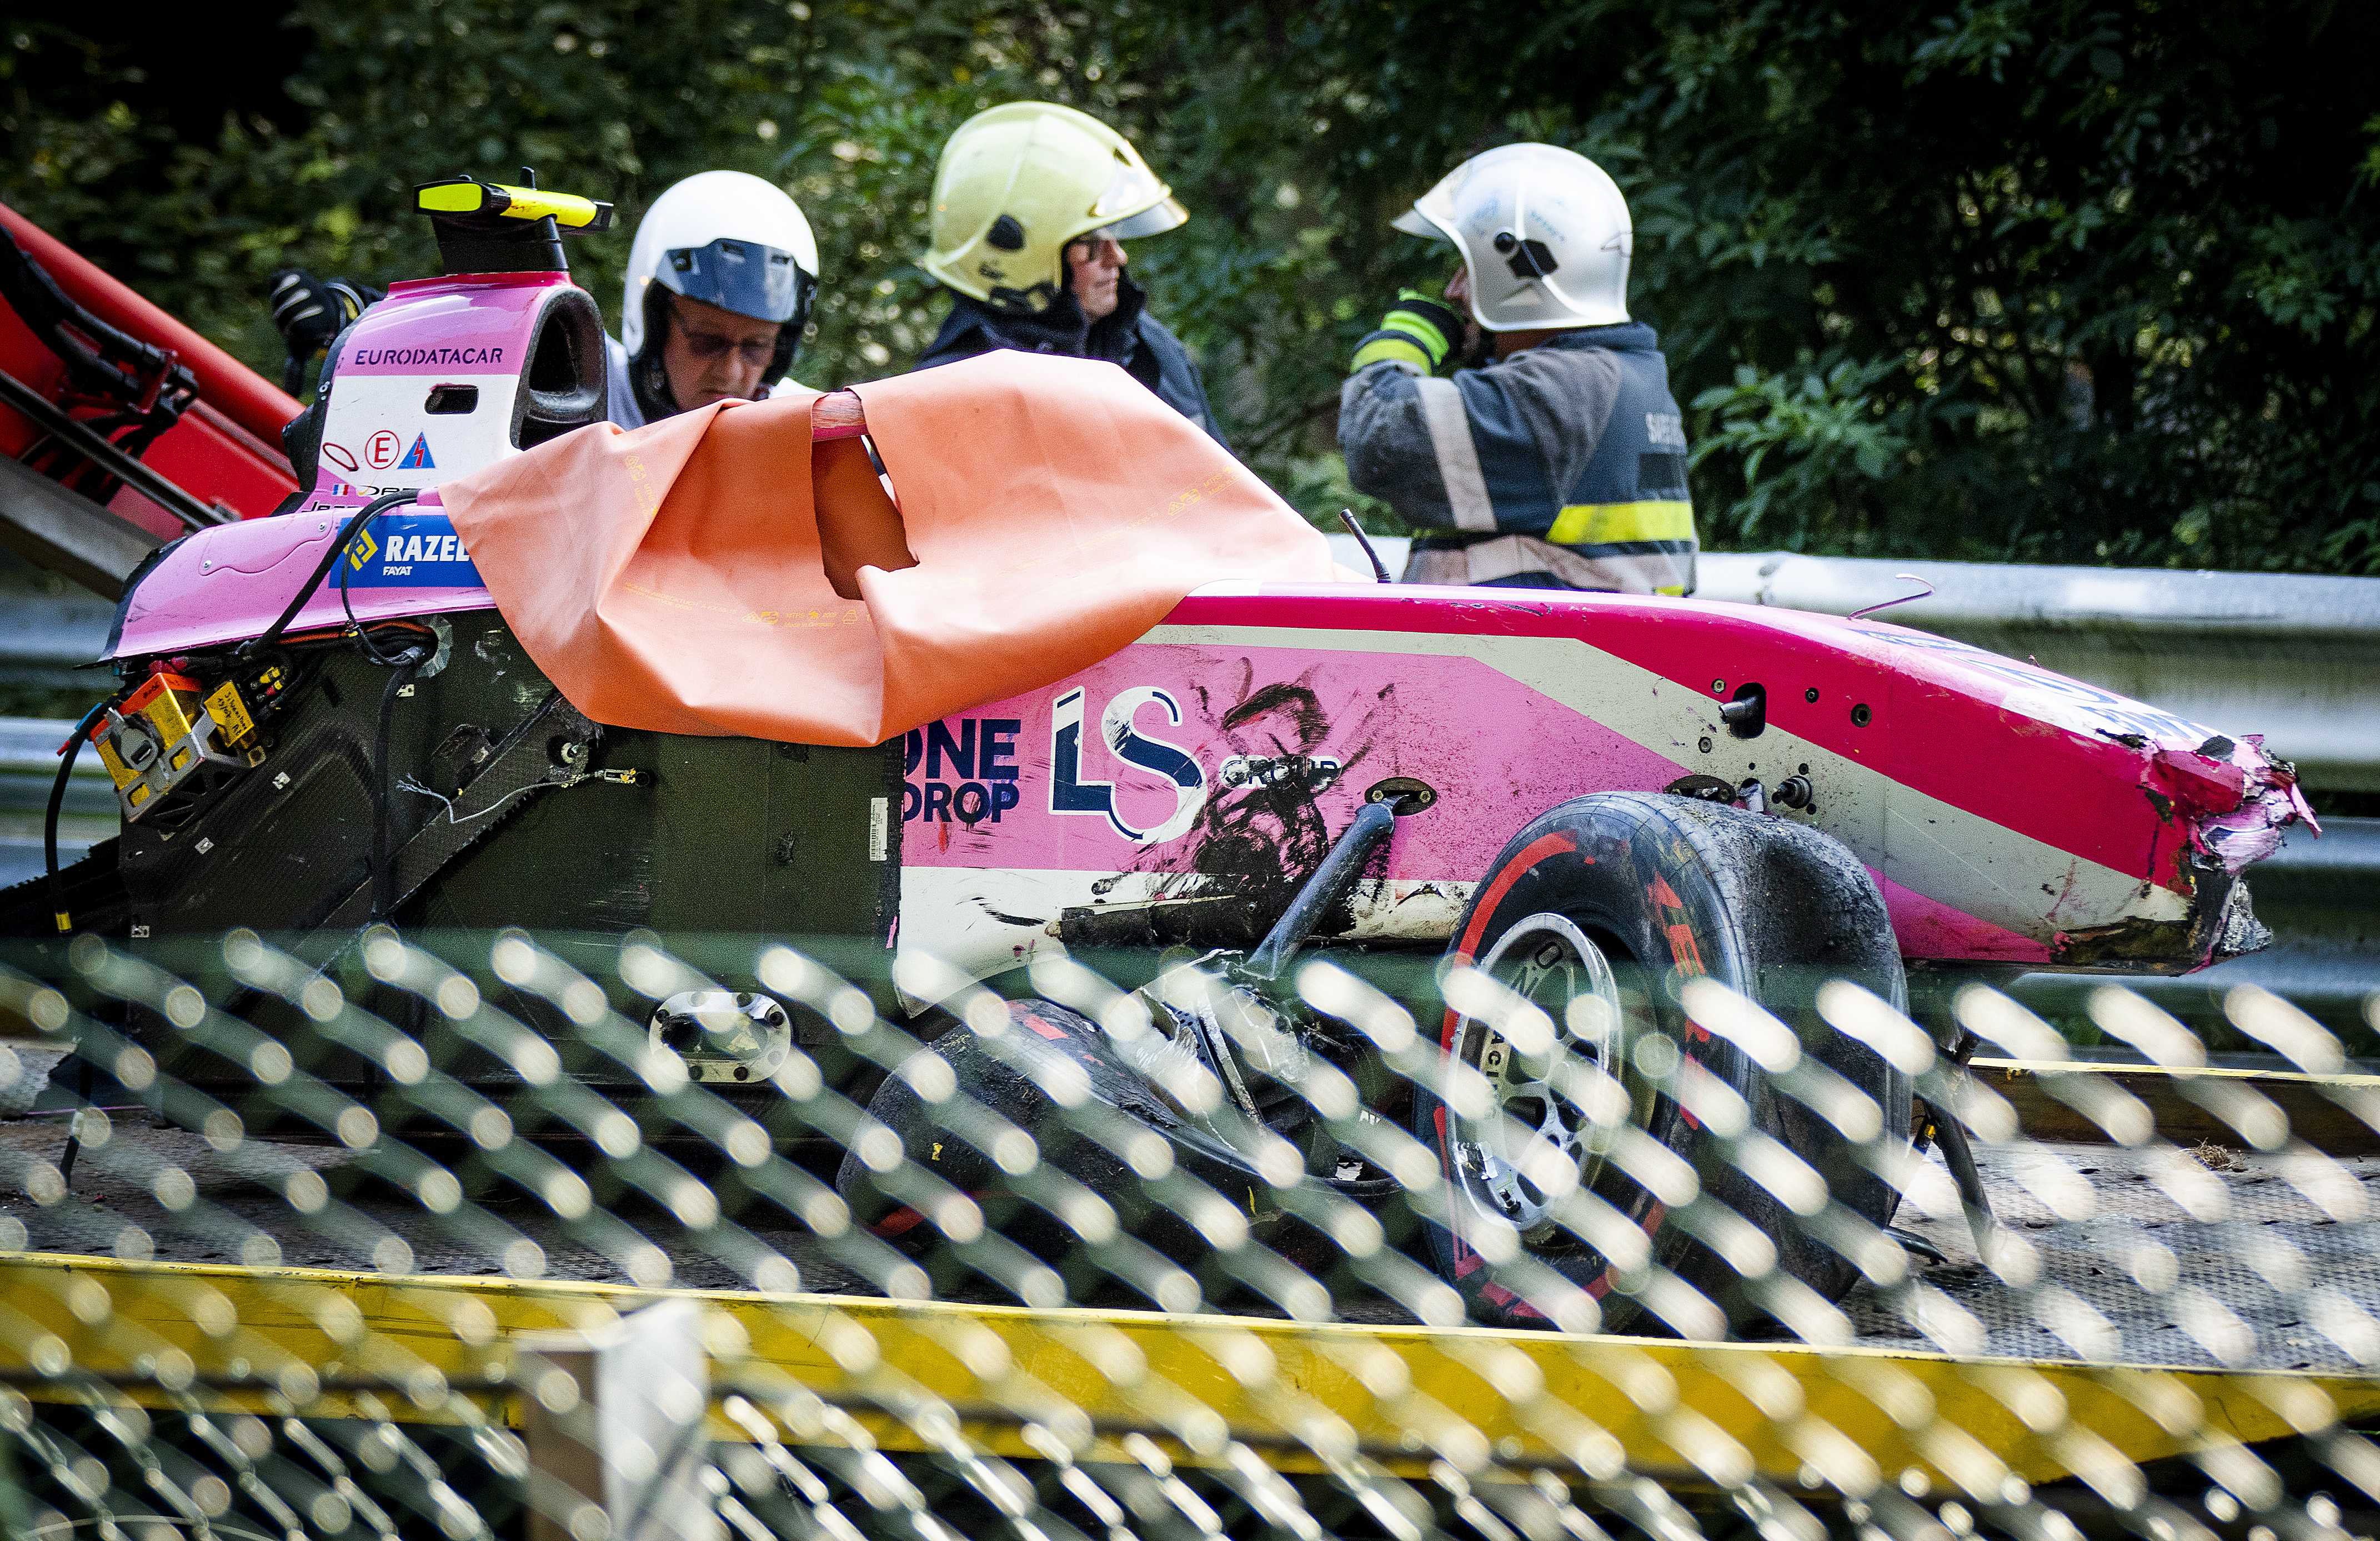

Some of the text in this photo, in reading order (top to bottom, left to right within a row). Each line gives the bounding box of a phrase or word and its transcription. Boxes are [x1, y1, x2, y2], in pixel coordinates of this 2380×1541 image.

[355, 348, 503, 366] EURODATACAR
[374, 437, 390, 463] E
[385, 535, 470, 562] RAZEL
[382, 566, 413, 576] FAYAT
[1049, 686, 1209, 844] LS
